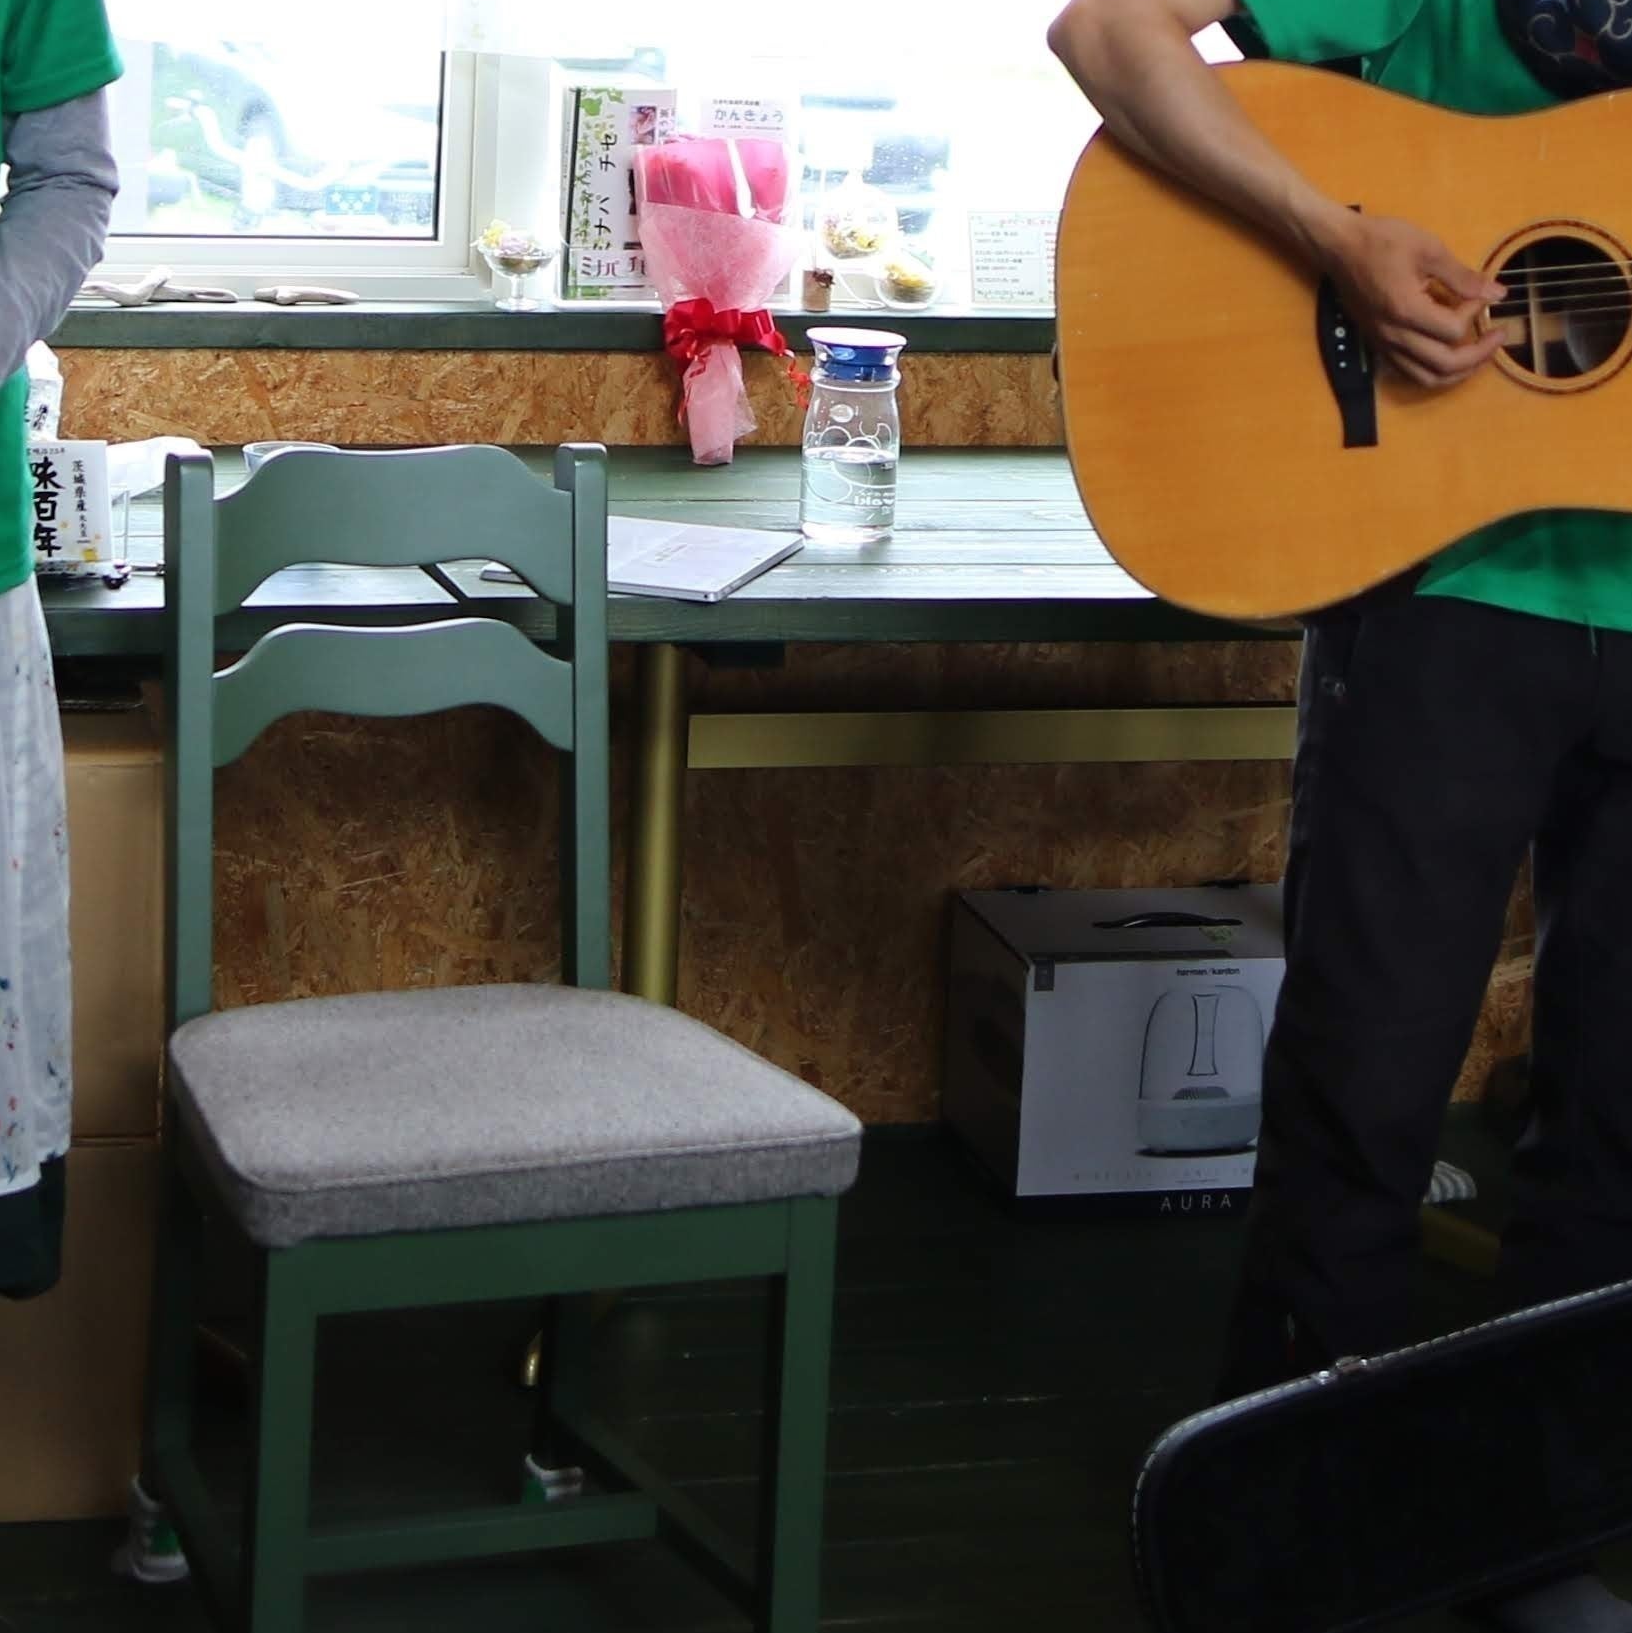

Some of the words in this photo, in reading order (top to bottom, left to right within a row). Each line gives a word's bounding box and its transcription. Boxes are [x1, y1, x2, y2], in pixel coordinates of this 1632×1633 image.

[714, 108, 784, 123] かんきょう
[30, 455, 66, 558] 味百年
[1159, 1193, 1233, 1212] AURA
